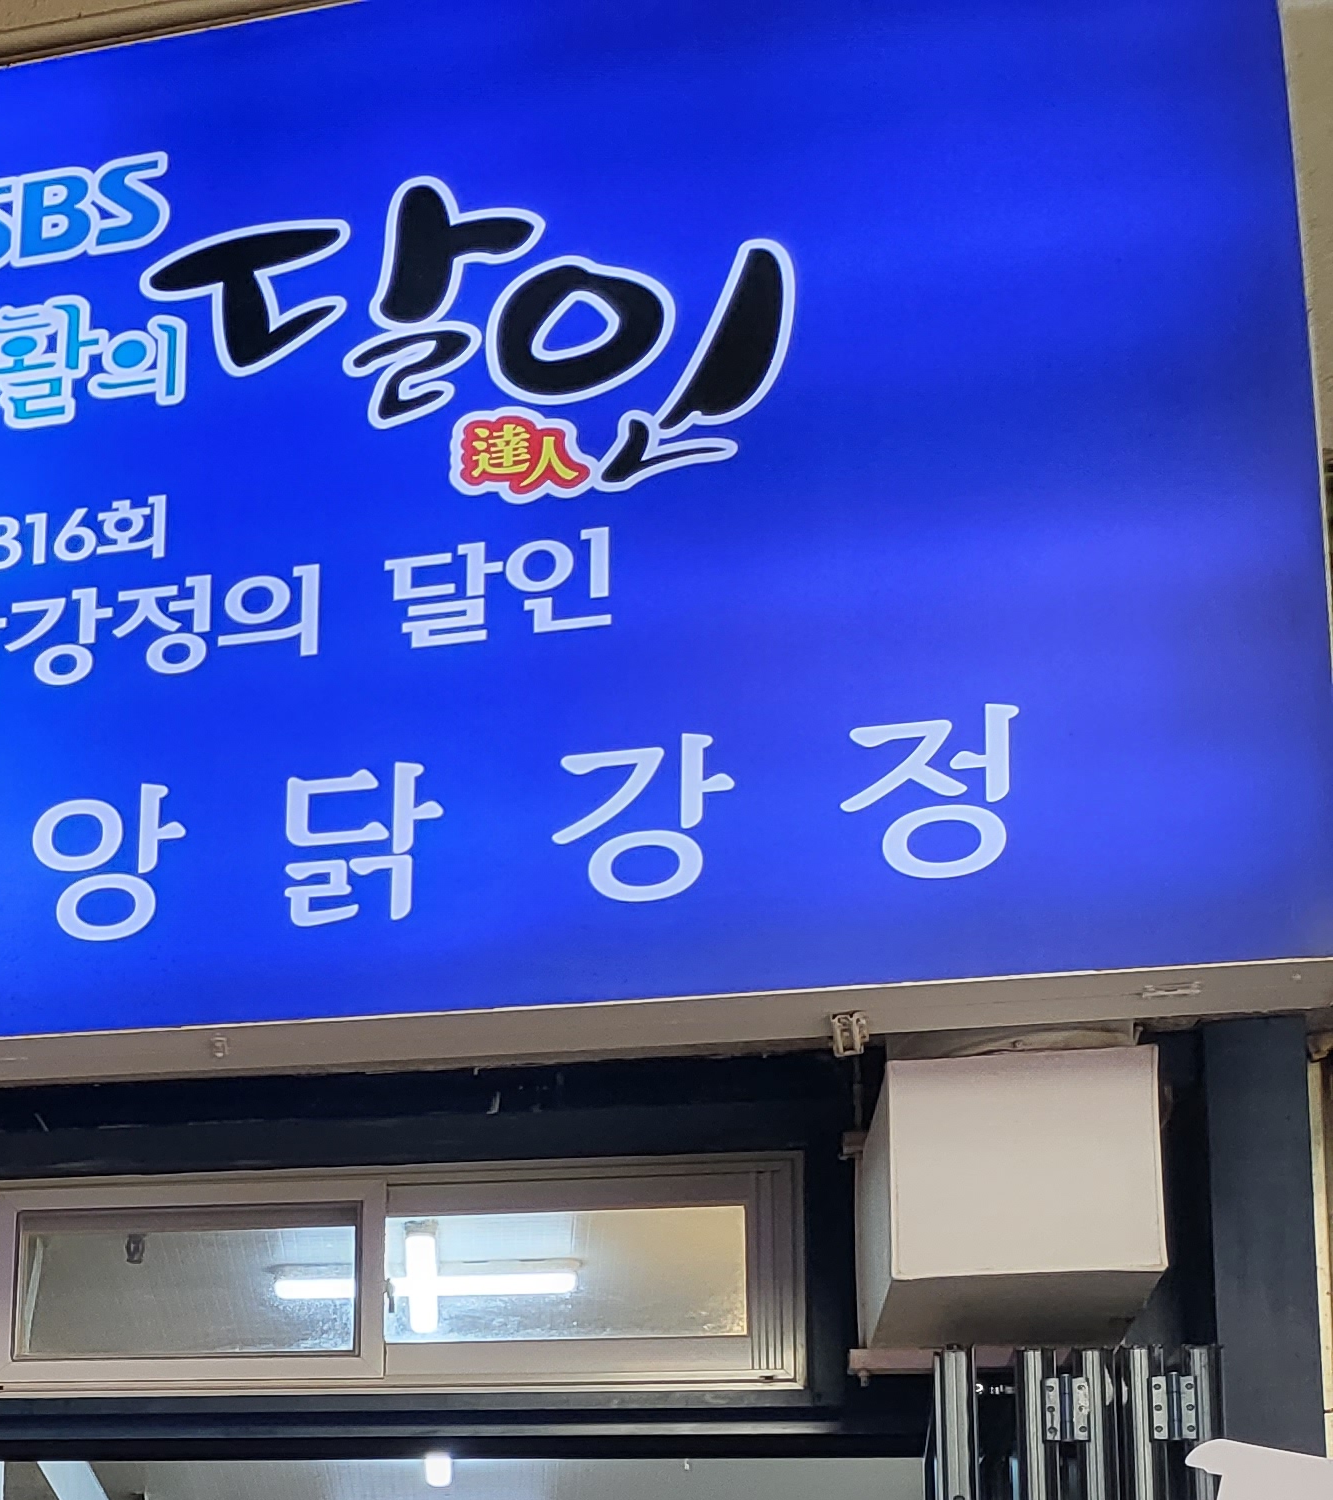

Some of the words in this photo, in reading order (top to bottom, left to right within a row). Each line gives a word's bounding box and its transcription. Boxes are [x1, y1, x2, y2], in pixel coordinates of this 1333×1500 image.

[139, 175, 796, 492] 달인
[468, 420, 587, 488] 達人
[384, 526, 612, 650] 달인
